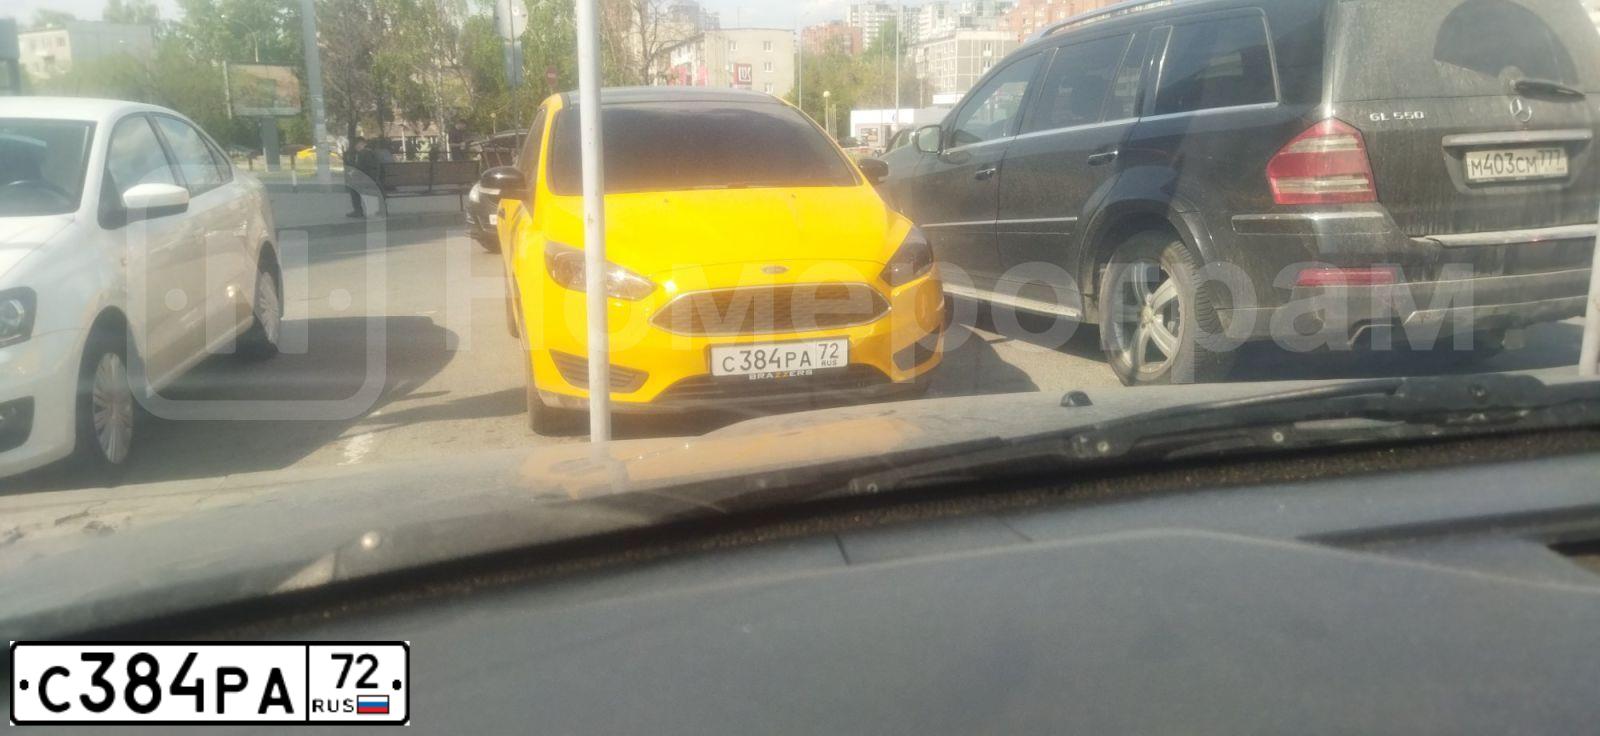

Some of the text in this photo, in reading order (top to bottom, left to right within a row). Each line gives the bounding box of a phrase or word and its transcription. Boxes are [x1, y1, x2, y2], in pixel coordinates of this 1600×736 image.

[1369, 111, 1424, 121] GL 550
[818, 343, 839, 359] 72
[749, 370, 813, 380] BRAZZERS
